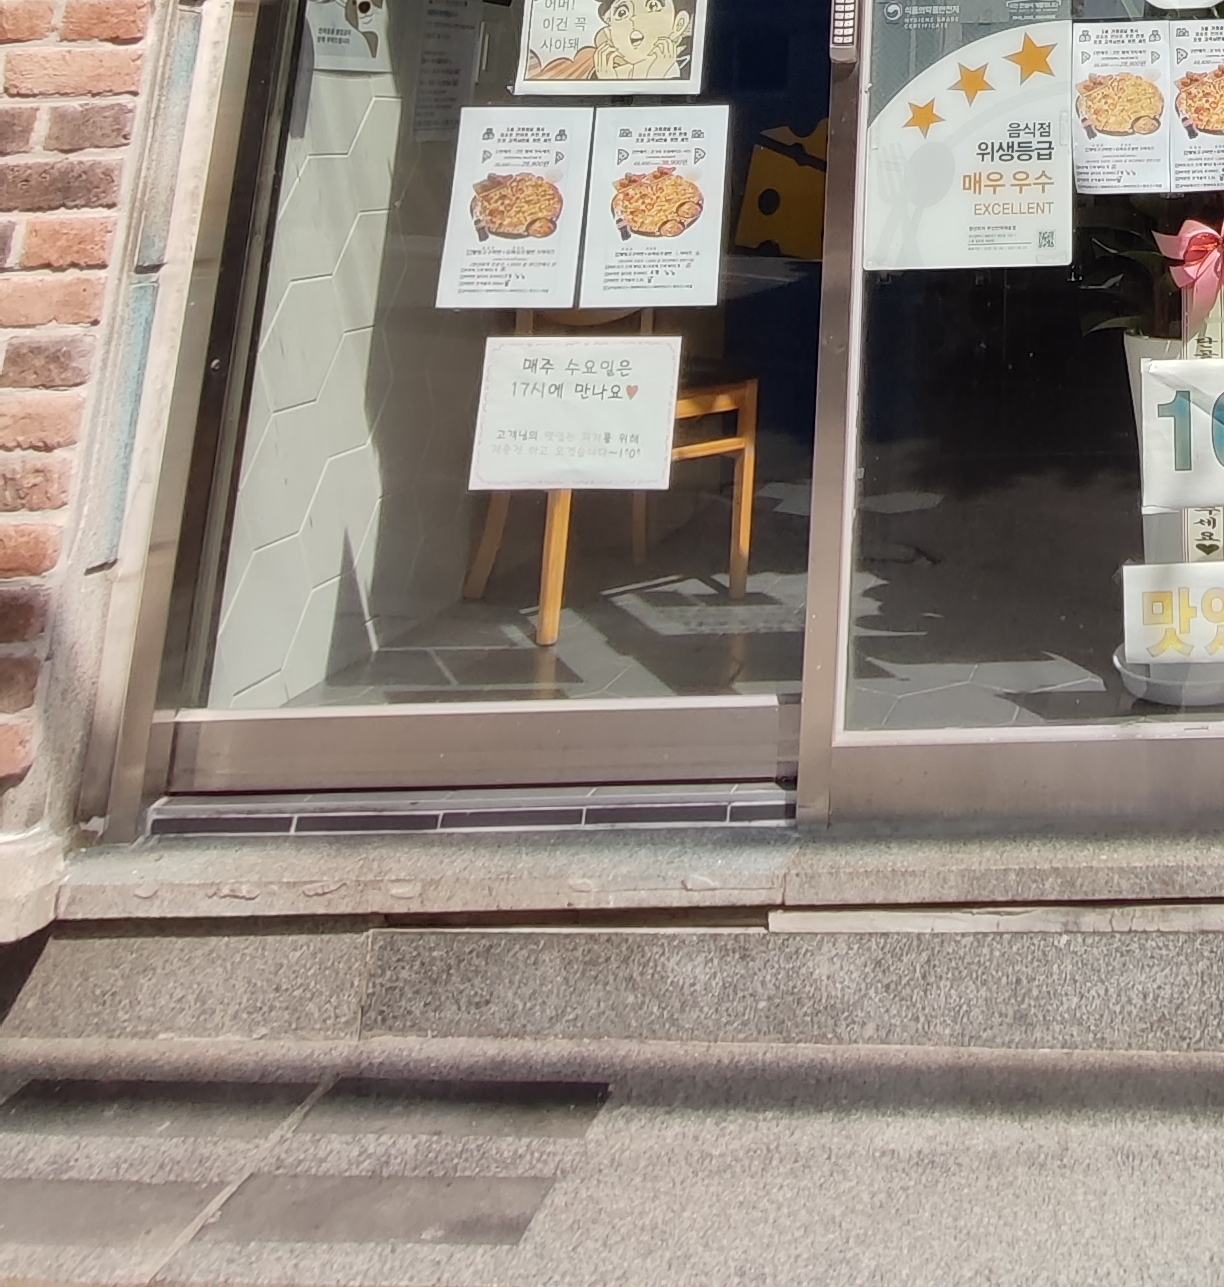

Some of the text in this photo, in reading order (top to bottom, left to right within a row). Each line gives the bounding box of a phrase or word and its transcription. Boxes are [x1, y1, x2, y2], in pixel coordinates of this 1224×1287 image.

[543, 16, 587, 32] 이건 꼭
[1007, 122, 1052, 138] 음식점
[976, 140, 1055, 162] 위생등급
[962, 170, 1055, 196] 매우 우수
[973, 202, 1055, 216] EXCELLENT
[522, 358, 633, 378] 매주 수요일은
[511, 381, 564, 399] 17시에
[496, 430, 538, 441] 고객님의
[619, 433, 640, 444] 위해
